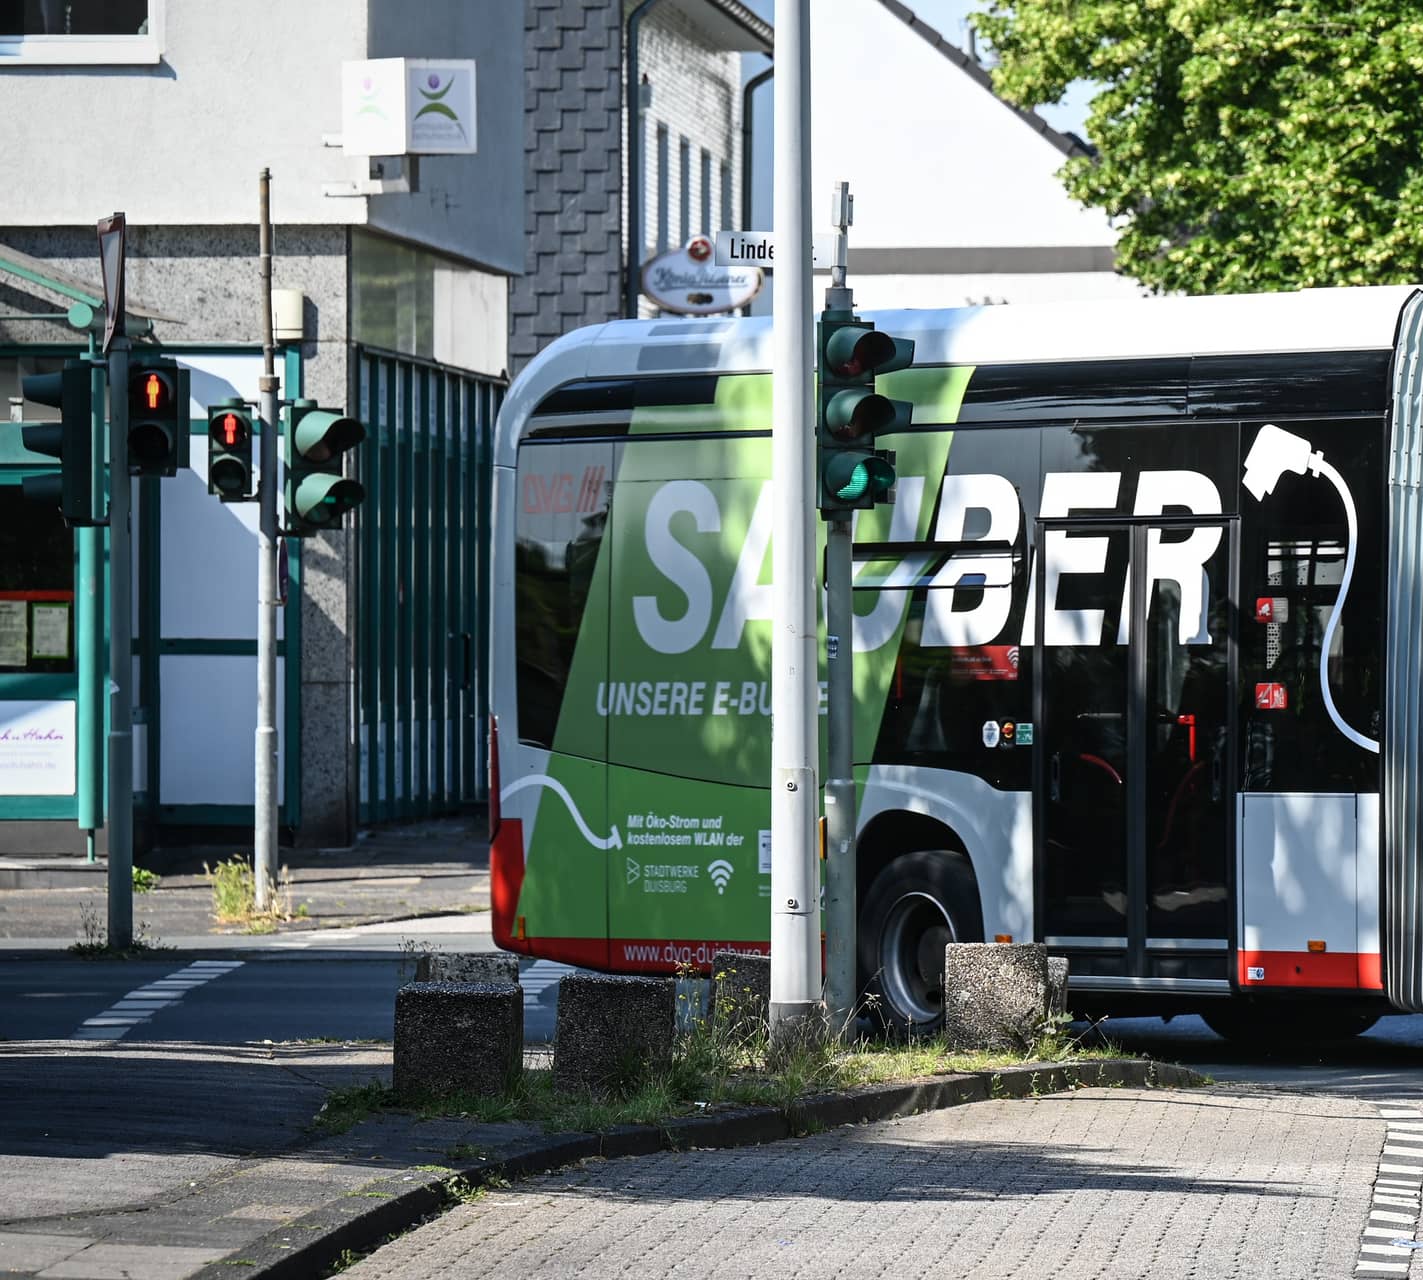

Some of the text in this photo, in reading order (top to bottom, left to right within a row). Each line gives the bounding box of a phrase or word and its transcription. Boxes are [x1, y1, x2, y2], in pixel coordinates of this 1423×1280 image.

[596, 681, 829, 717] UNSERE E-BUE
[627, 812, 723, 829] Mit Öko-Strom und
[627, 832, 744, 847] kostenlosem WLAN der
[644, 865, 699, 878] STADTWERKE
[644, 880, 687, 893] DUISBURG
